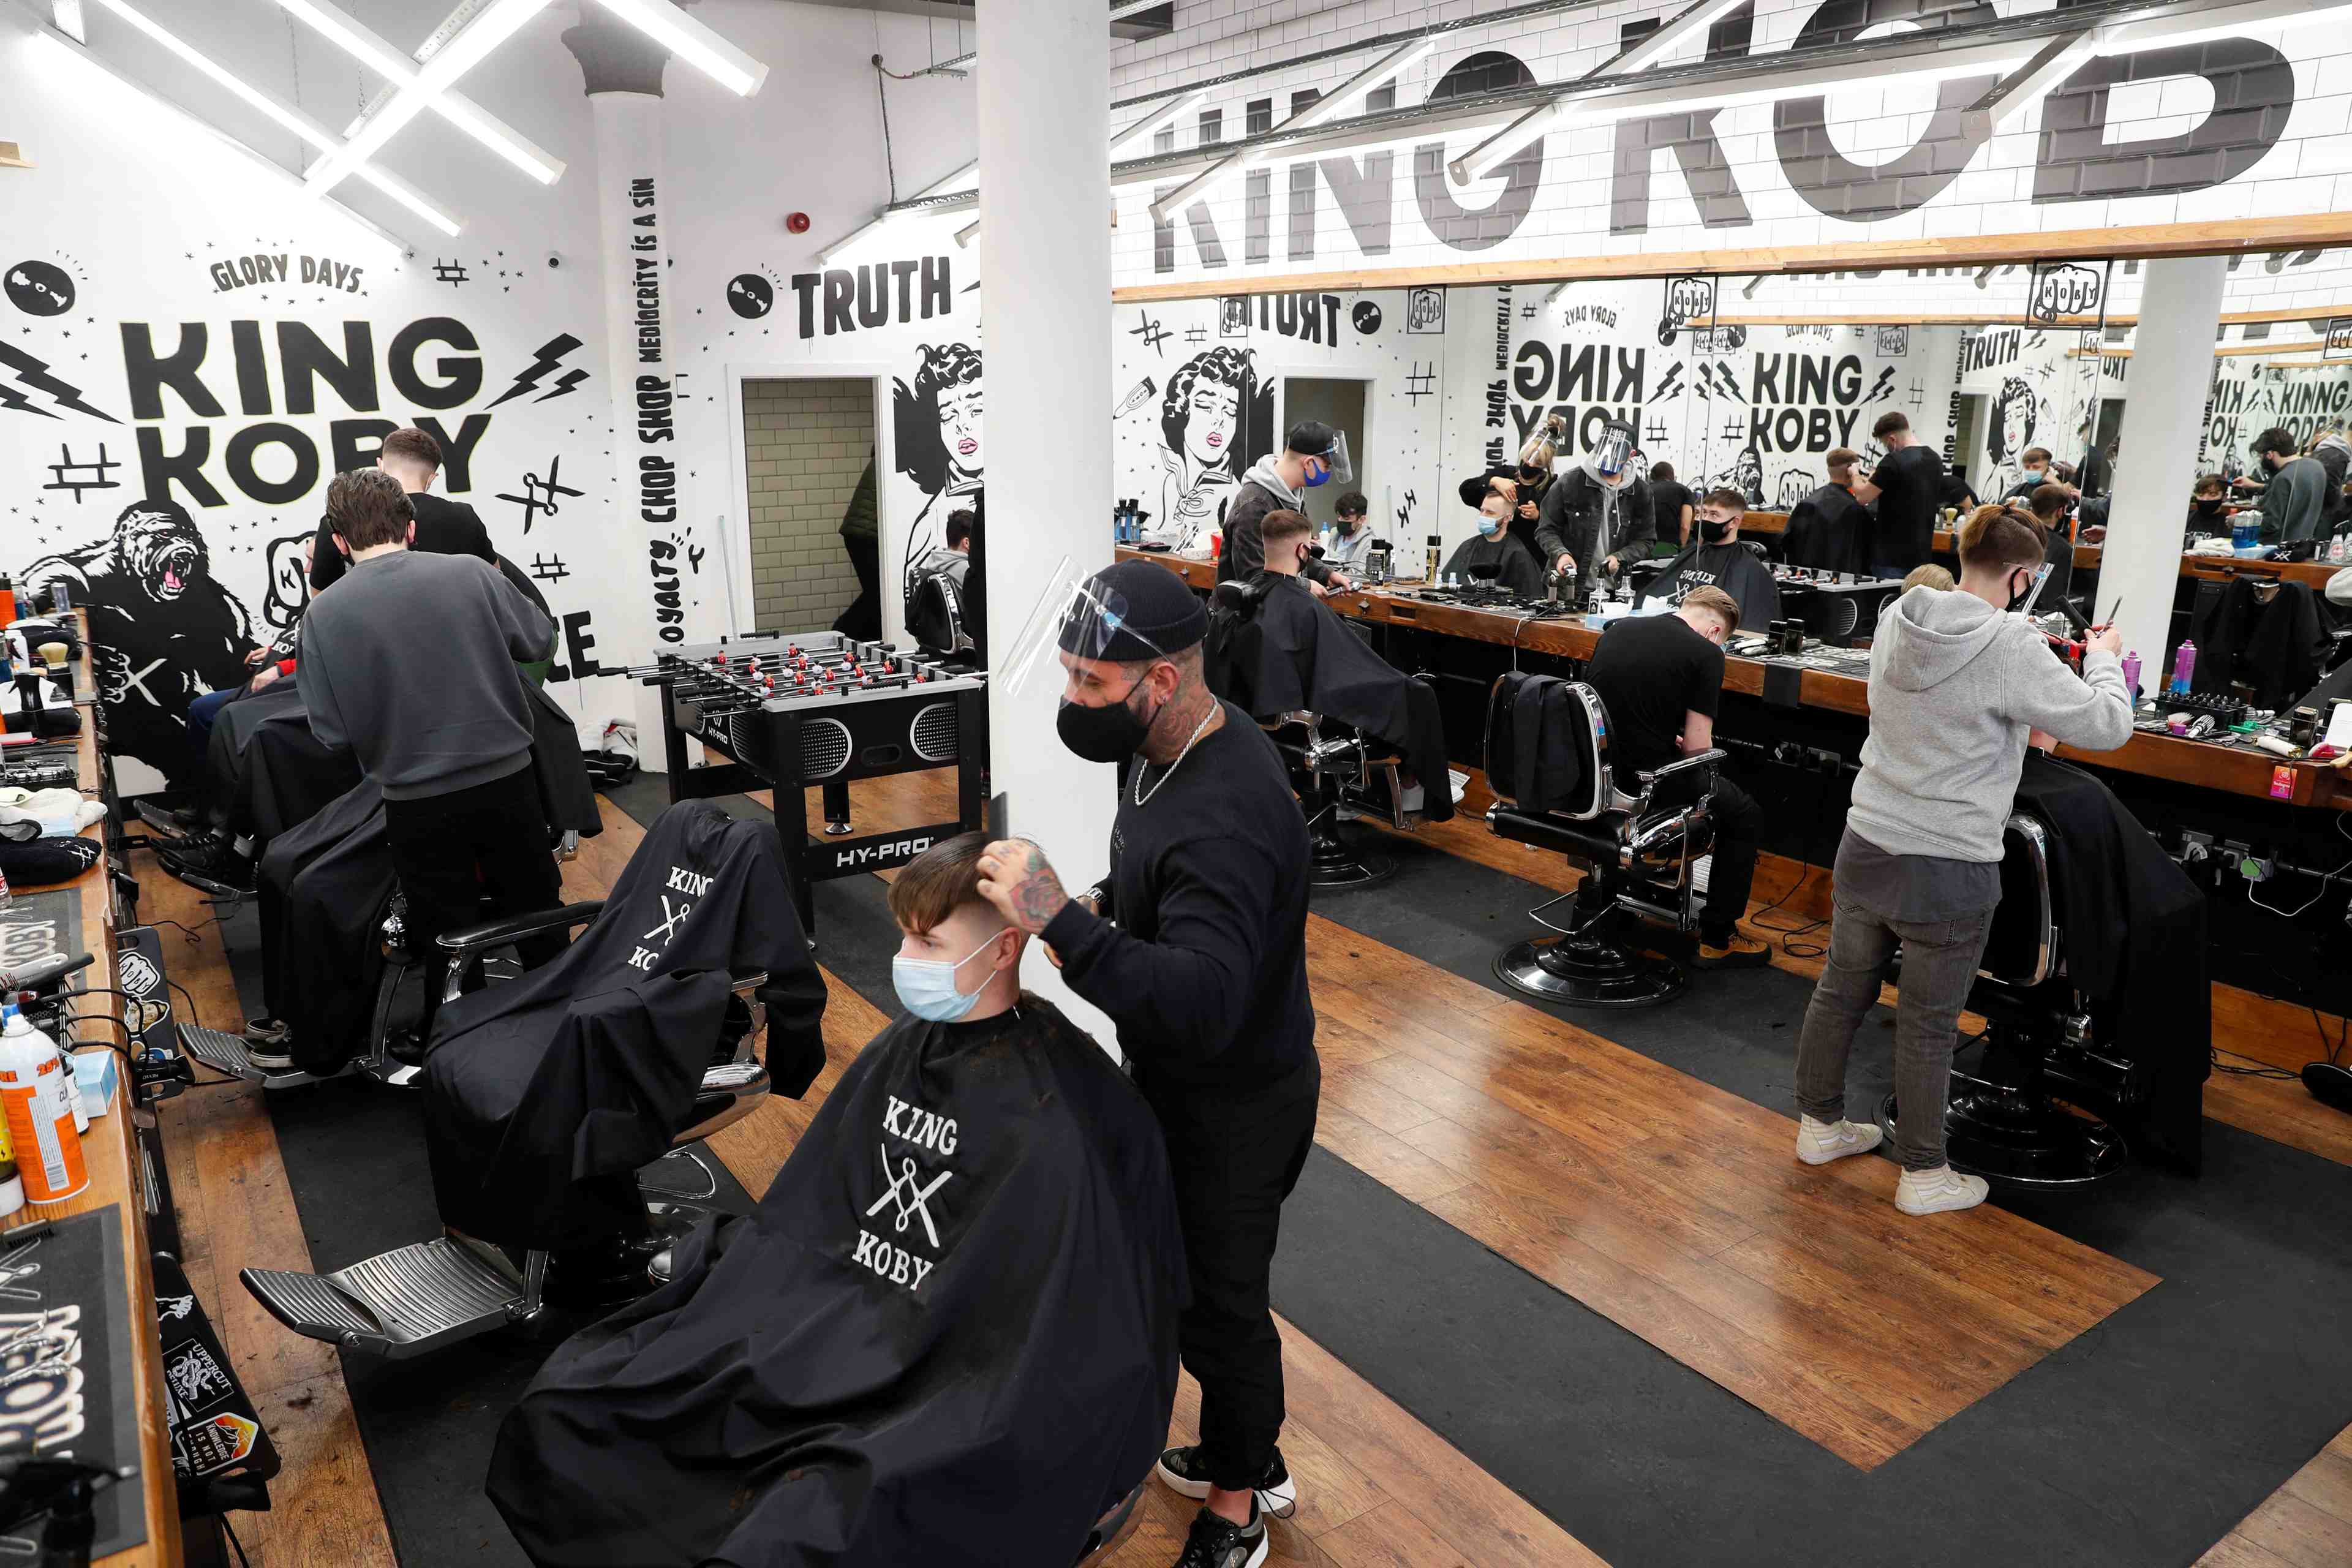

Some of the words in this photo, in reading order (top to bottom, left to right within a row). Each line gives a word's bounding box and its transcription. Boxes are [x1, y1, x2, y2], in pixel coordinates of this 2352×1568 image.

[1154, 51, 1544, 273] KING
[633, 213, 656, 227] A
[210, 254, 288, 292] GLORY
[301, 255, 363, 293] DAYS
[2045, 286, 2096, 300] KOBY
[792, 255, 951, 340] TRUTH
[119, 317, 483, 419] KING
[1964, 329, 2021, 372] TRUTH
[1752, 352, 1862, 405] KING
[636, 375, 674, 443] SHOP
[1749, 407, 1860, 453] KOBY
[639, 456, 676, 522] CHOP
[649, 540, 684, 646] OYALTY
[709, 726, 728, 745] HY-PRO
[837, 837, 930, 867] HY-PRO
[883, 1095, 957, 1155] KING
[851, 1229, 933, 1291] KOBY
[192, 1343, 232, 1389] UPPERCUT
[195, 1431, 206, 1442] IS
[202, 1445, 216, 1462] NOT
[205, 1422, 230, 1461] KNOWLEDGE
